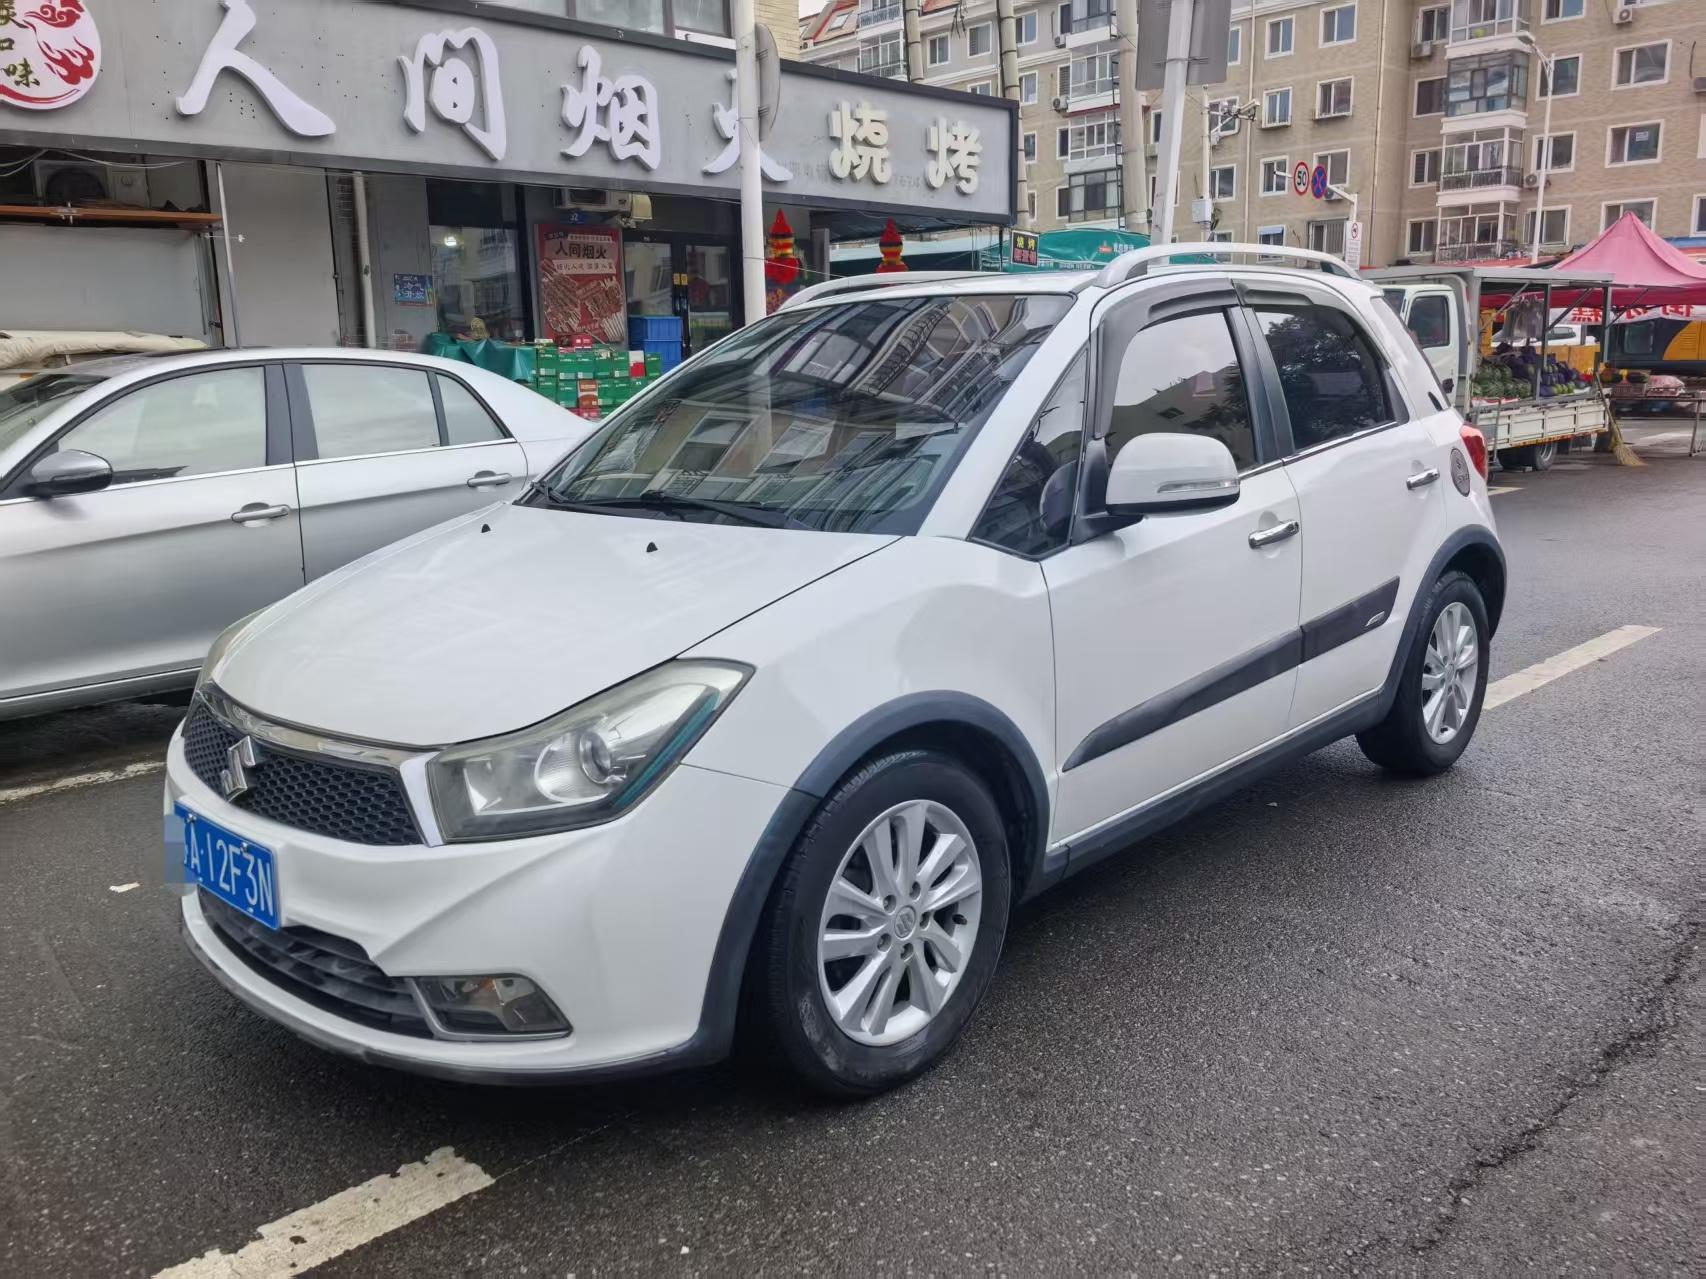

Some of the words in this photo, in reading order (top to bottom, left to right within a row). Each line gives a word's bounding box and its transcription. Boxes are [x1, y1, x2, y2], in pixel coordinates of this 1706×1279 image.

[176, 0, 794, 182] 人间烟火
[828, 99, 983, 195] 烧烤
[1297, 170, 1307, 187] 50
[555, 241, 607, 259] 人间烟火
[184, 820, 274, 917] A·12F3N
